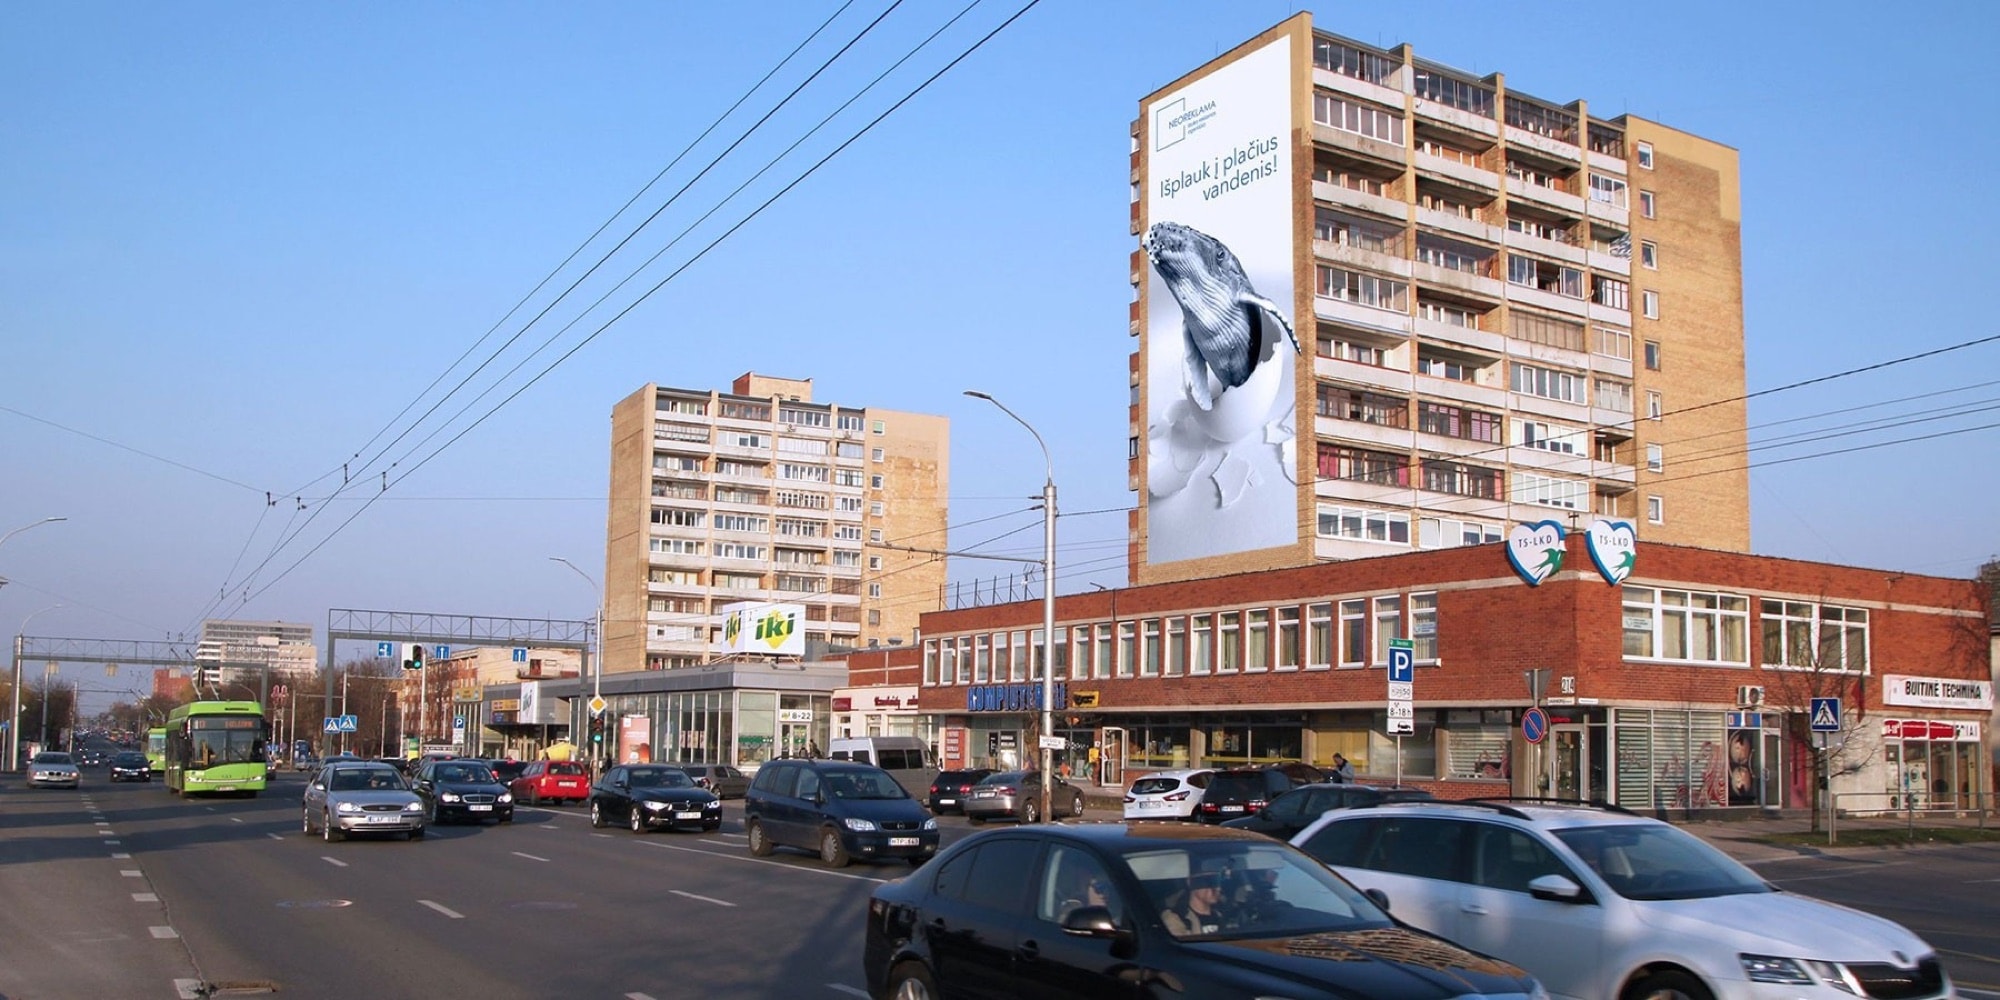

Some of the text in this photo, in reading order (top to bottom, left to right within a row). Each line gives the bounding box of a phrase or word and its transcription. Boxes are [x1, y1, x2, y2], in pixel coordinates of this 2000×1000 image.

[1168, 100, 1217, 130] NEOREKLAMA
[1160, 136, 1278, 199] Išplauk į plačius
[1203, 154, 1278, 201] vandenis!
[1518, 534, 1552, 548] TS-LKD
[1599, 535, 1629, 548] TS-LKD
[725, 610, 742, 641] iki
[755, 613, 795, 640] iki
[1395, 651, 1409, 679] P
[1905, 680, 1982, 699] BUITINĖ TECHNIKA
[456, 718, 463, 728] P
[792, 712, 811, 720] 8-22
